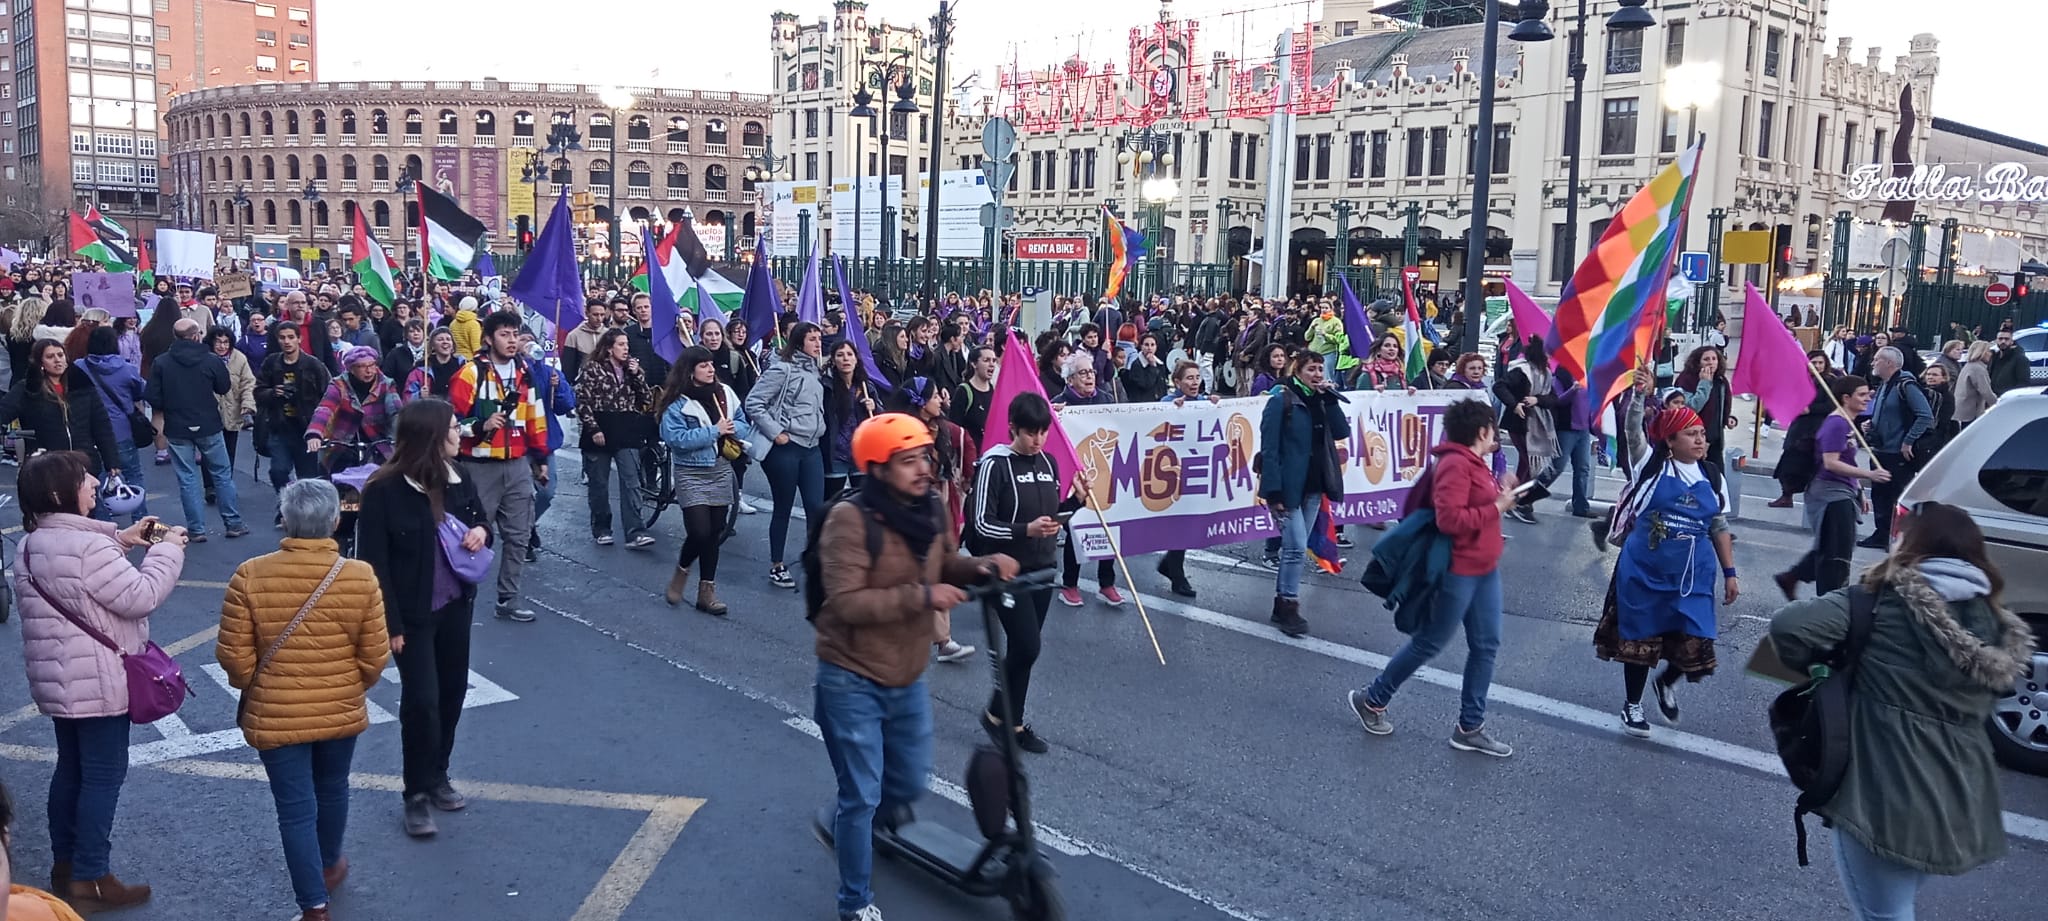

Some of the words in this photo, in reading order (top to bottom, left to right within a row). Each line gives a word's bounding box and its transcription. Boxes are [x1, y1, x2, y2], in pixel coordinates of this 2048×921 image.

[1847, 164, 1974, 201] Falla
[1028, 243, 1049, 255] RENT
[1048, 243, 1056, 255] A
[1055, 243, 1075, 255] BIKE
[1197, 418, 1225, 443] LA
